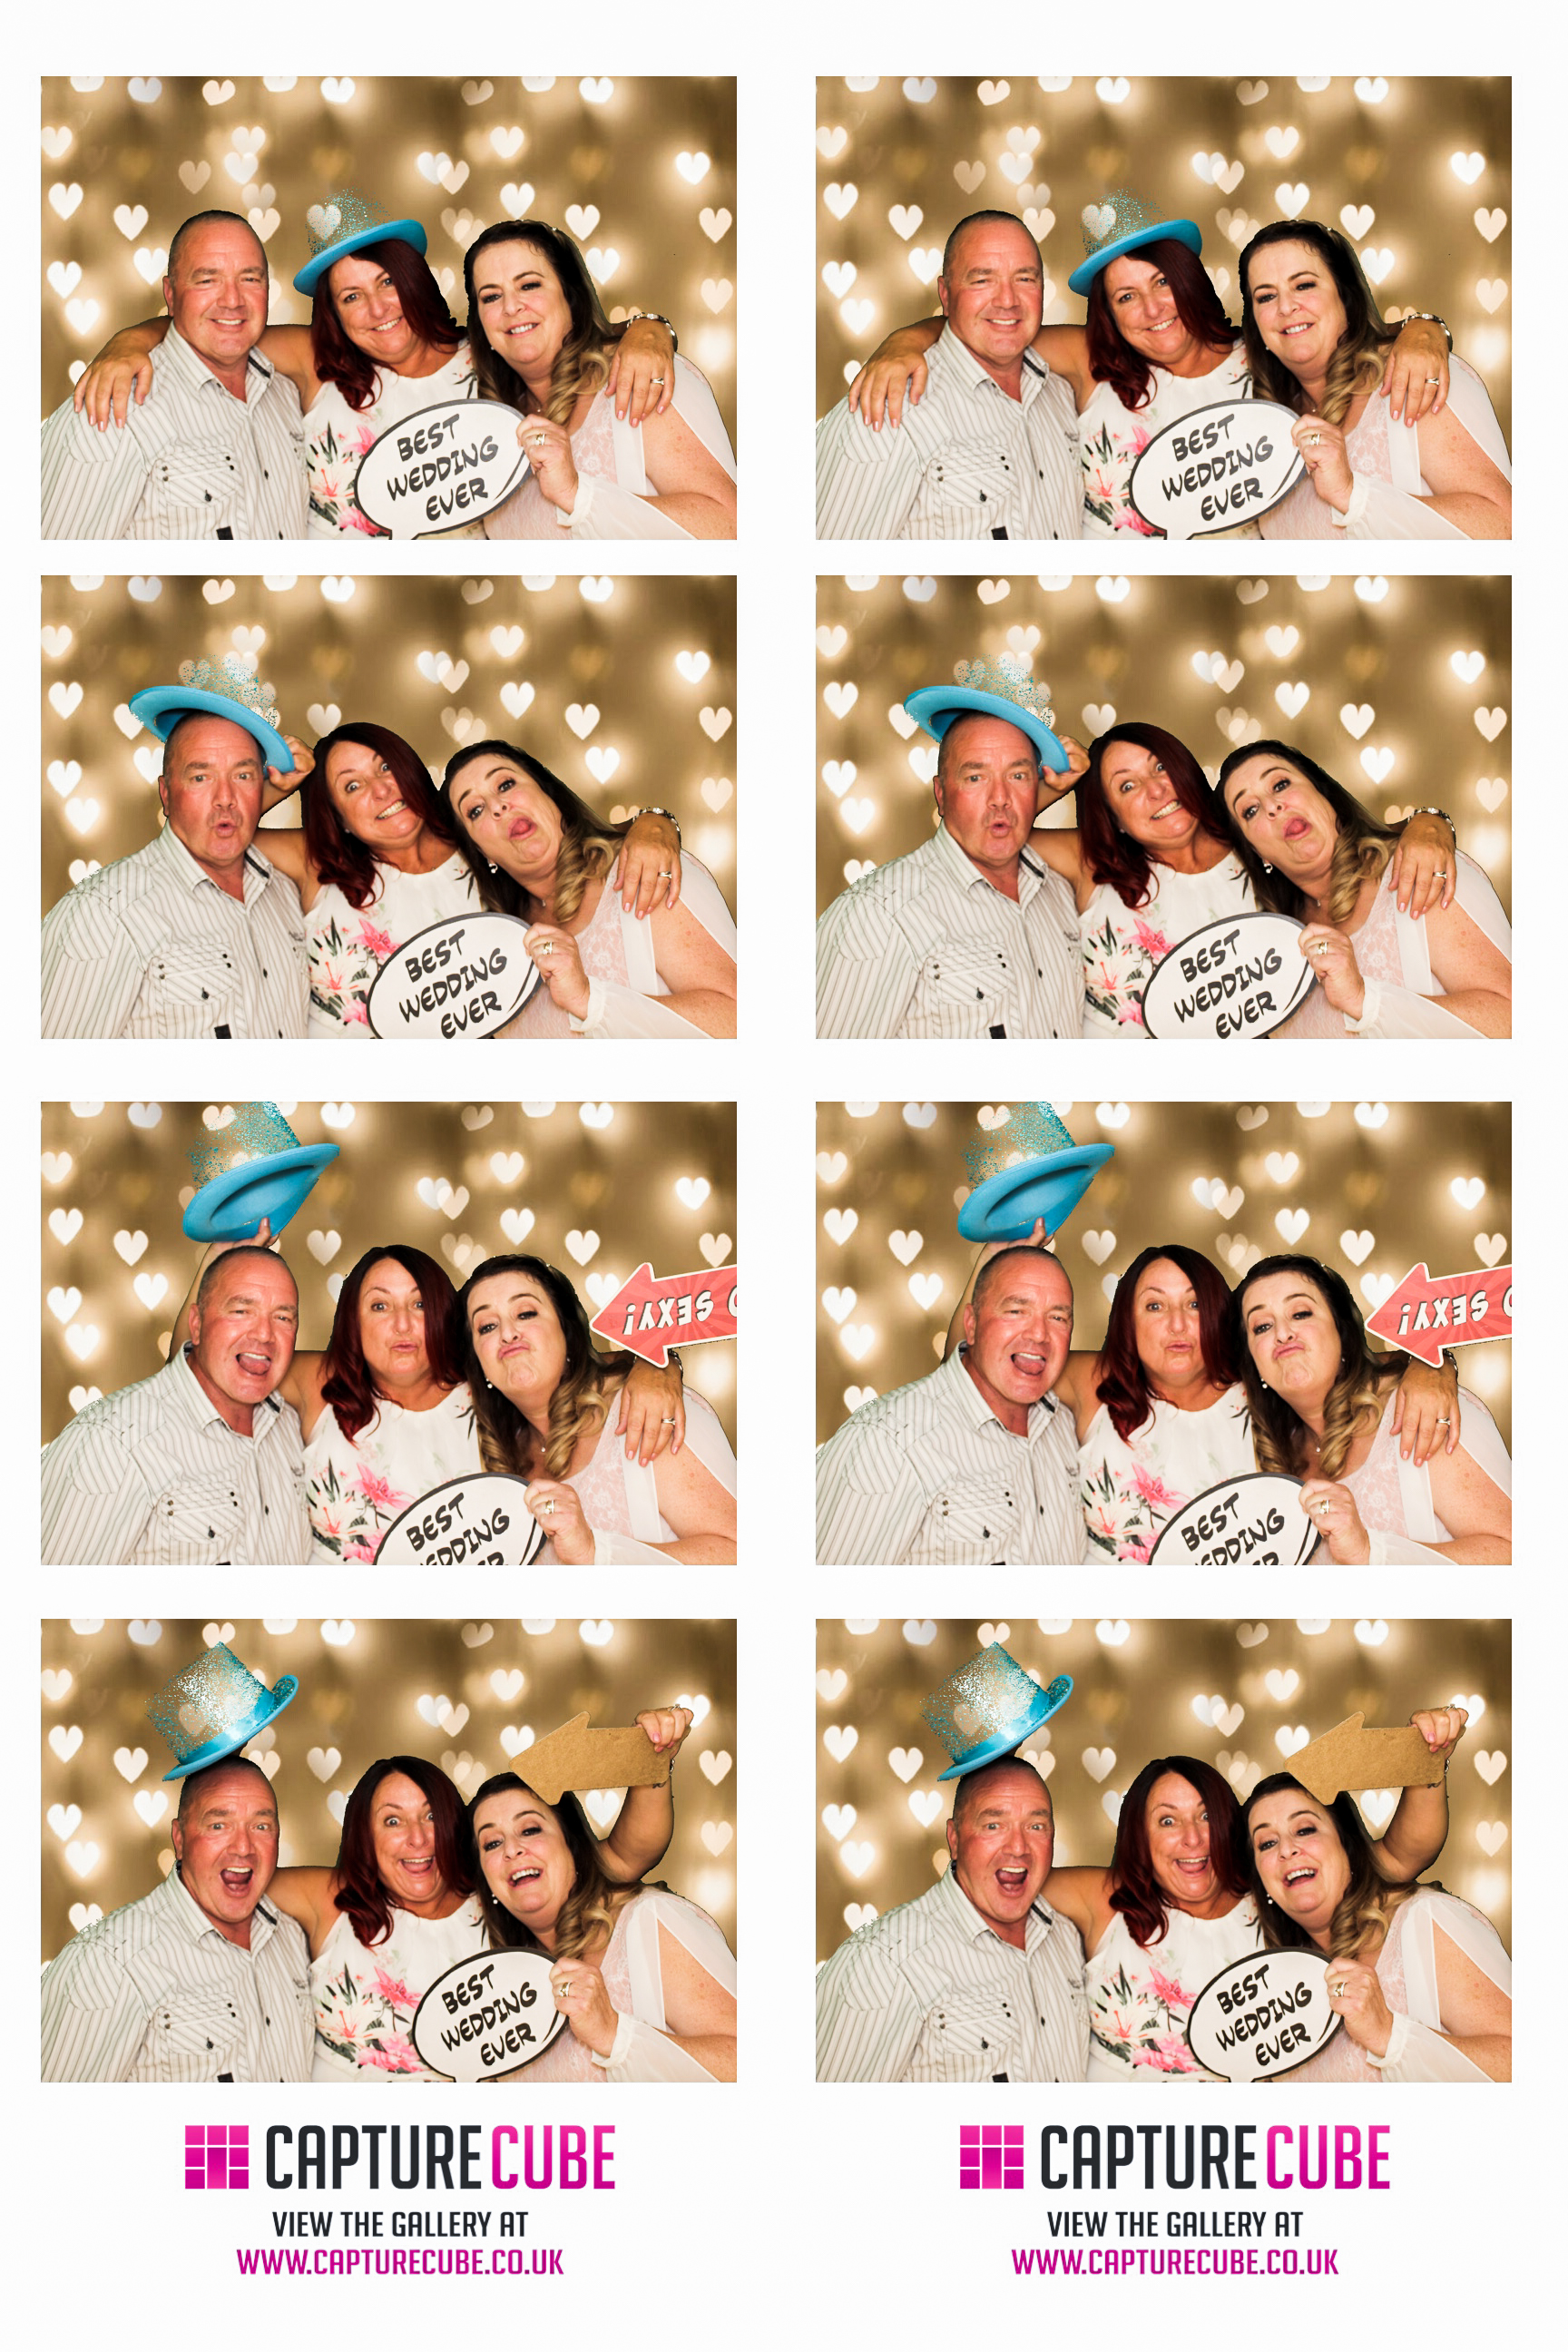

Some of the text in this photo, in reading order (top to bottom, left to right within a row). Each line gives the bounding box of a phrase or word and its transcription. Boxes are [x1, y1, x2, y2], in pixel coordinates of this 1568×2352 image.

[397, 414, 459, 461] BEST
[1172, 414, 1234, 461] BEST
[387, 436, 498, 501] WEDDING
[1162, 436, 1273, 501] WEDDING
[426, 478, 487, 521] EVER
[1201, 478, 1262, 521] EVER
[406, 929, 465, 983] BEST
[1181, 929, 1240, 983] BEST
[399, 948, 506, 1023] WEDDING
[1174, 948, 1281, 1023] WEDDING
[441, 991, 502, 1039] EVER
[1216, 991, 1277, 1039] EVER
[622, 1290, 714, 1336] SEXY!
[1397, 1290, 1489, 1336] SEXY!
[407, 1493, 464, 1551] BEST
[1181, 1493, 1239, 1551] BEST
[442, 1965, 494, 2014] BEST
[1217, 1965, 1269, 2014] BEST
[441, 1982, 536, 2051] WEDDING
[1216, 1982, 1311, 2051] WEDDING
[481, 2023, 536, 2066] EVER
[1256, 2023, 1311, 2066] EVER
